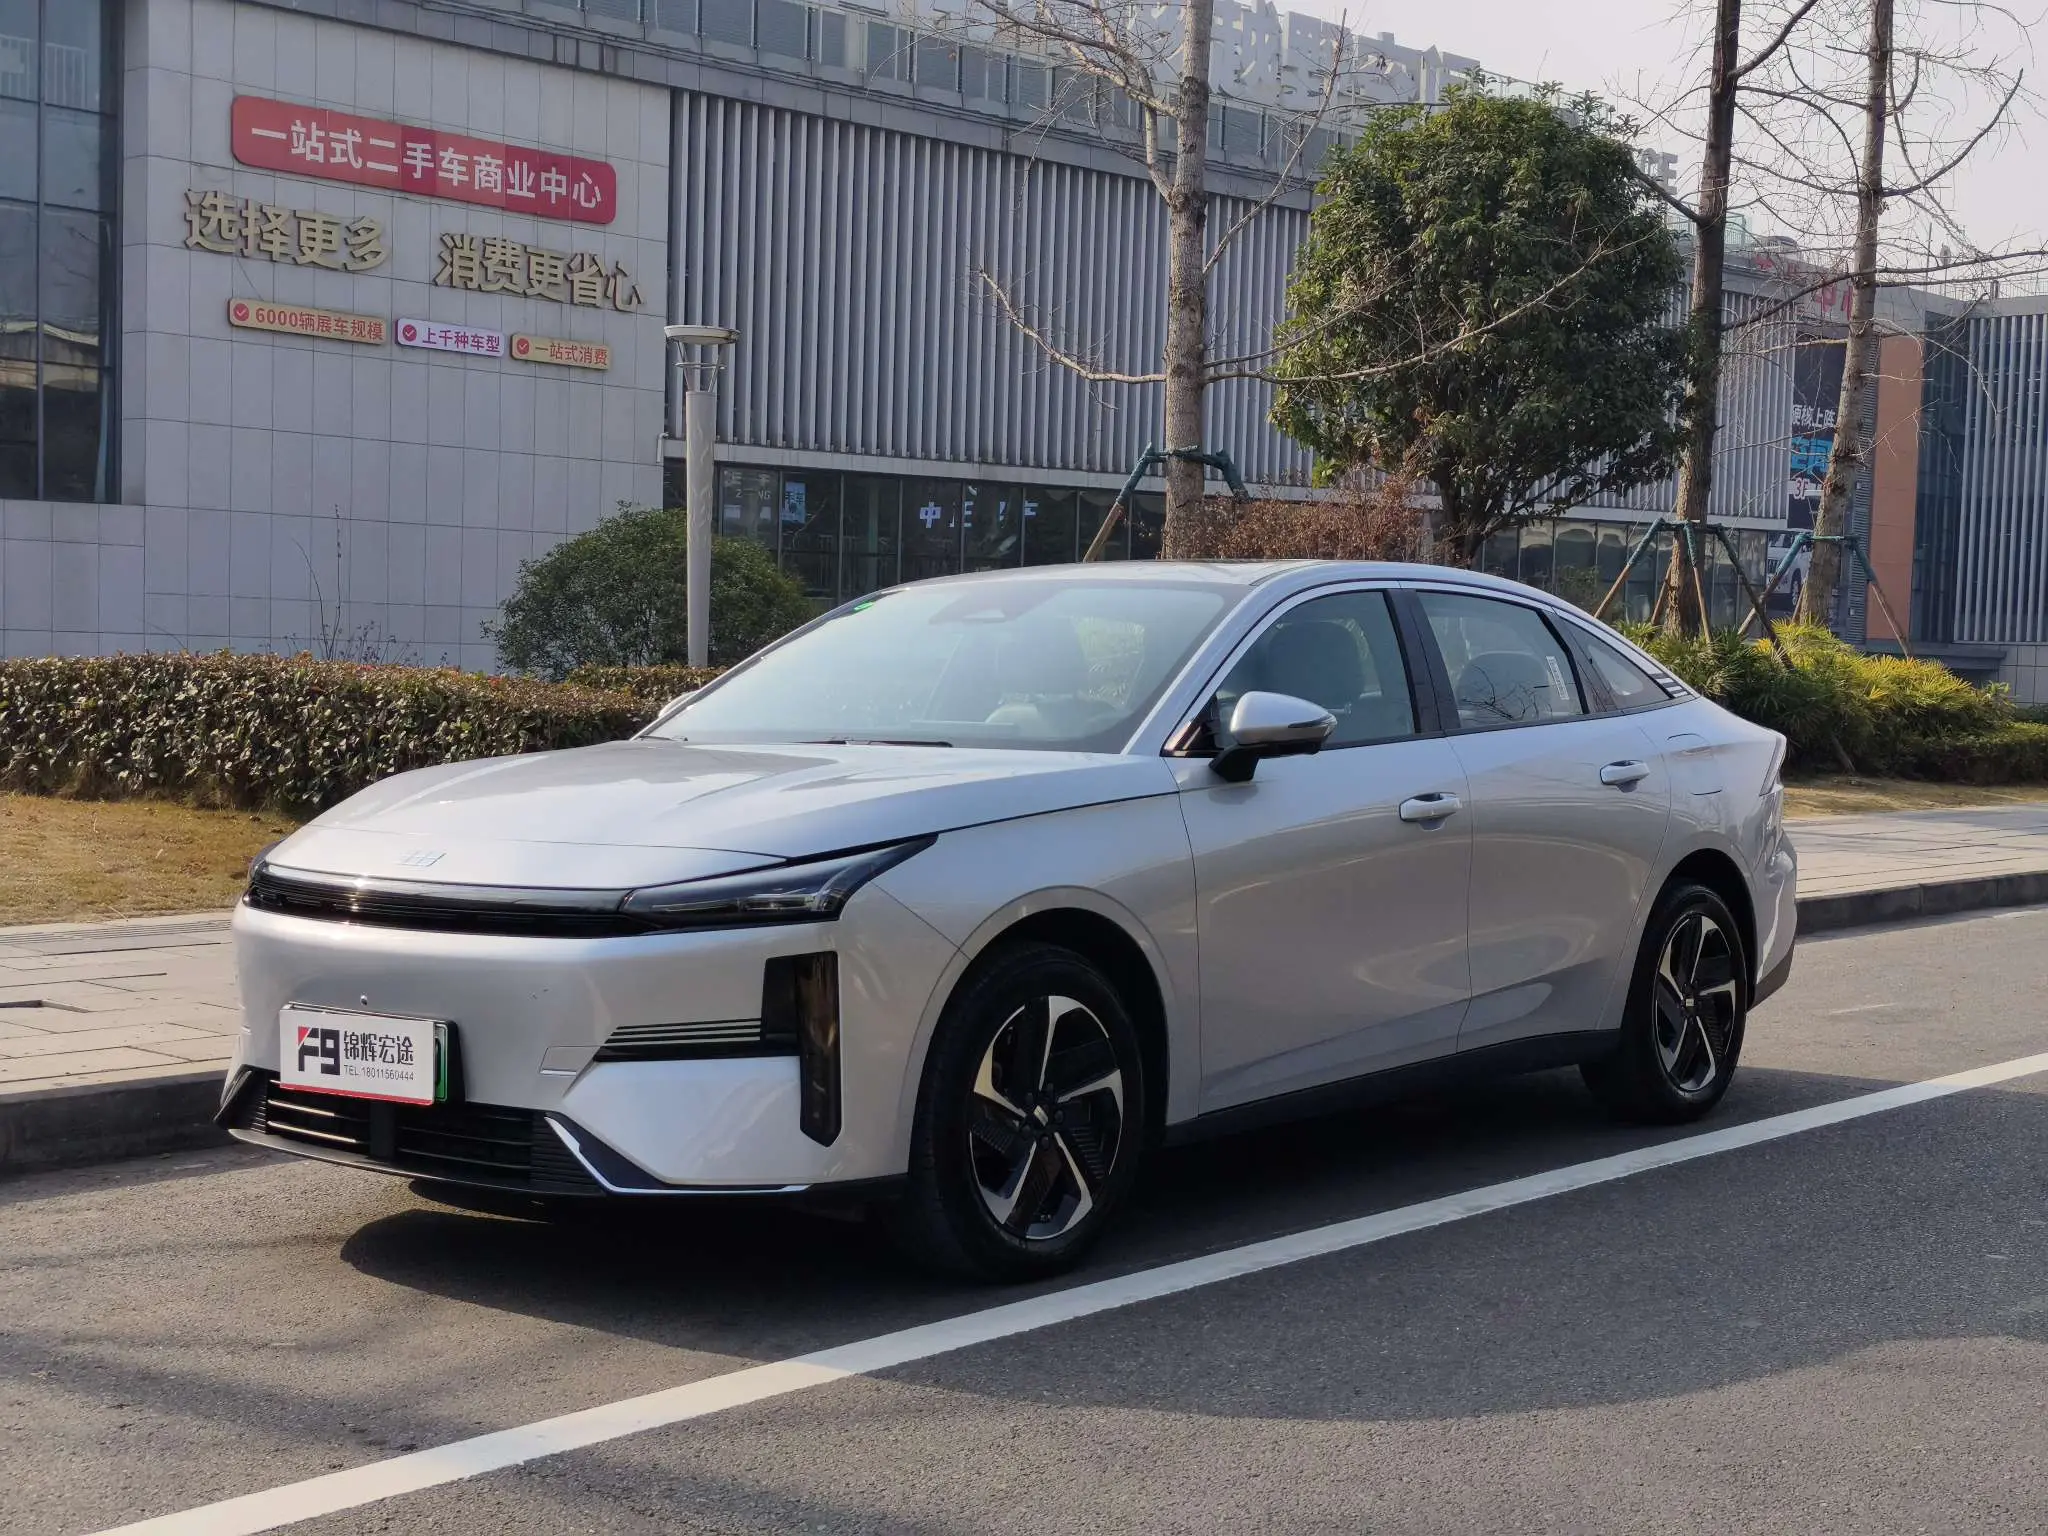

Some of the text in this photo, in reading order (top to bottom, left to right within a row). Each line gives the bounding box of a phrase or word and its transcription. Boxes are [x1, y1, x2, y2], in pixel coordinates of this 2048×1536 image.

[251, 119, 602, 209] 一站式二手车商业中心
[183, 188, 646, 312] 选择更多 消费更省心
[254, 307, 608, 367] 6000辆展车规模 上千种车型 一站式消费
[343, 1030, 415, 1066] 锦辉宏途
